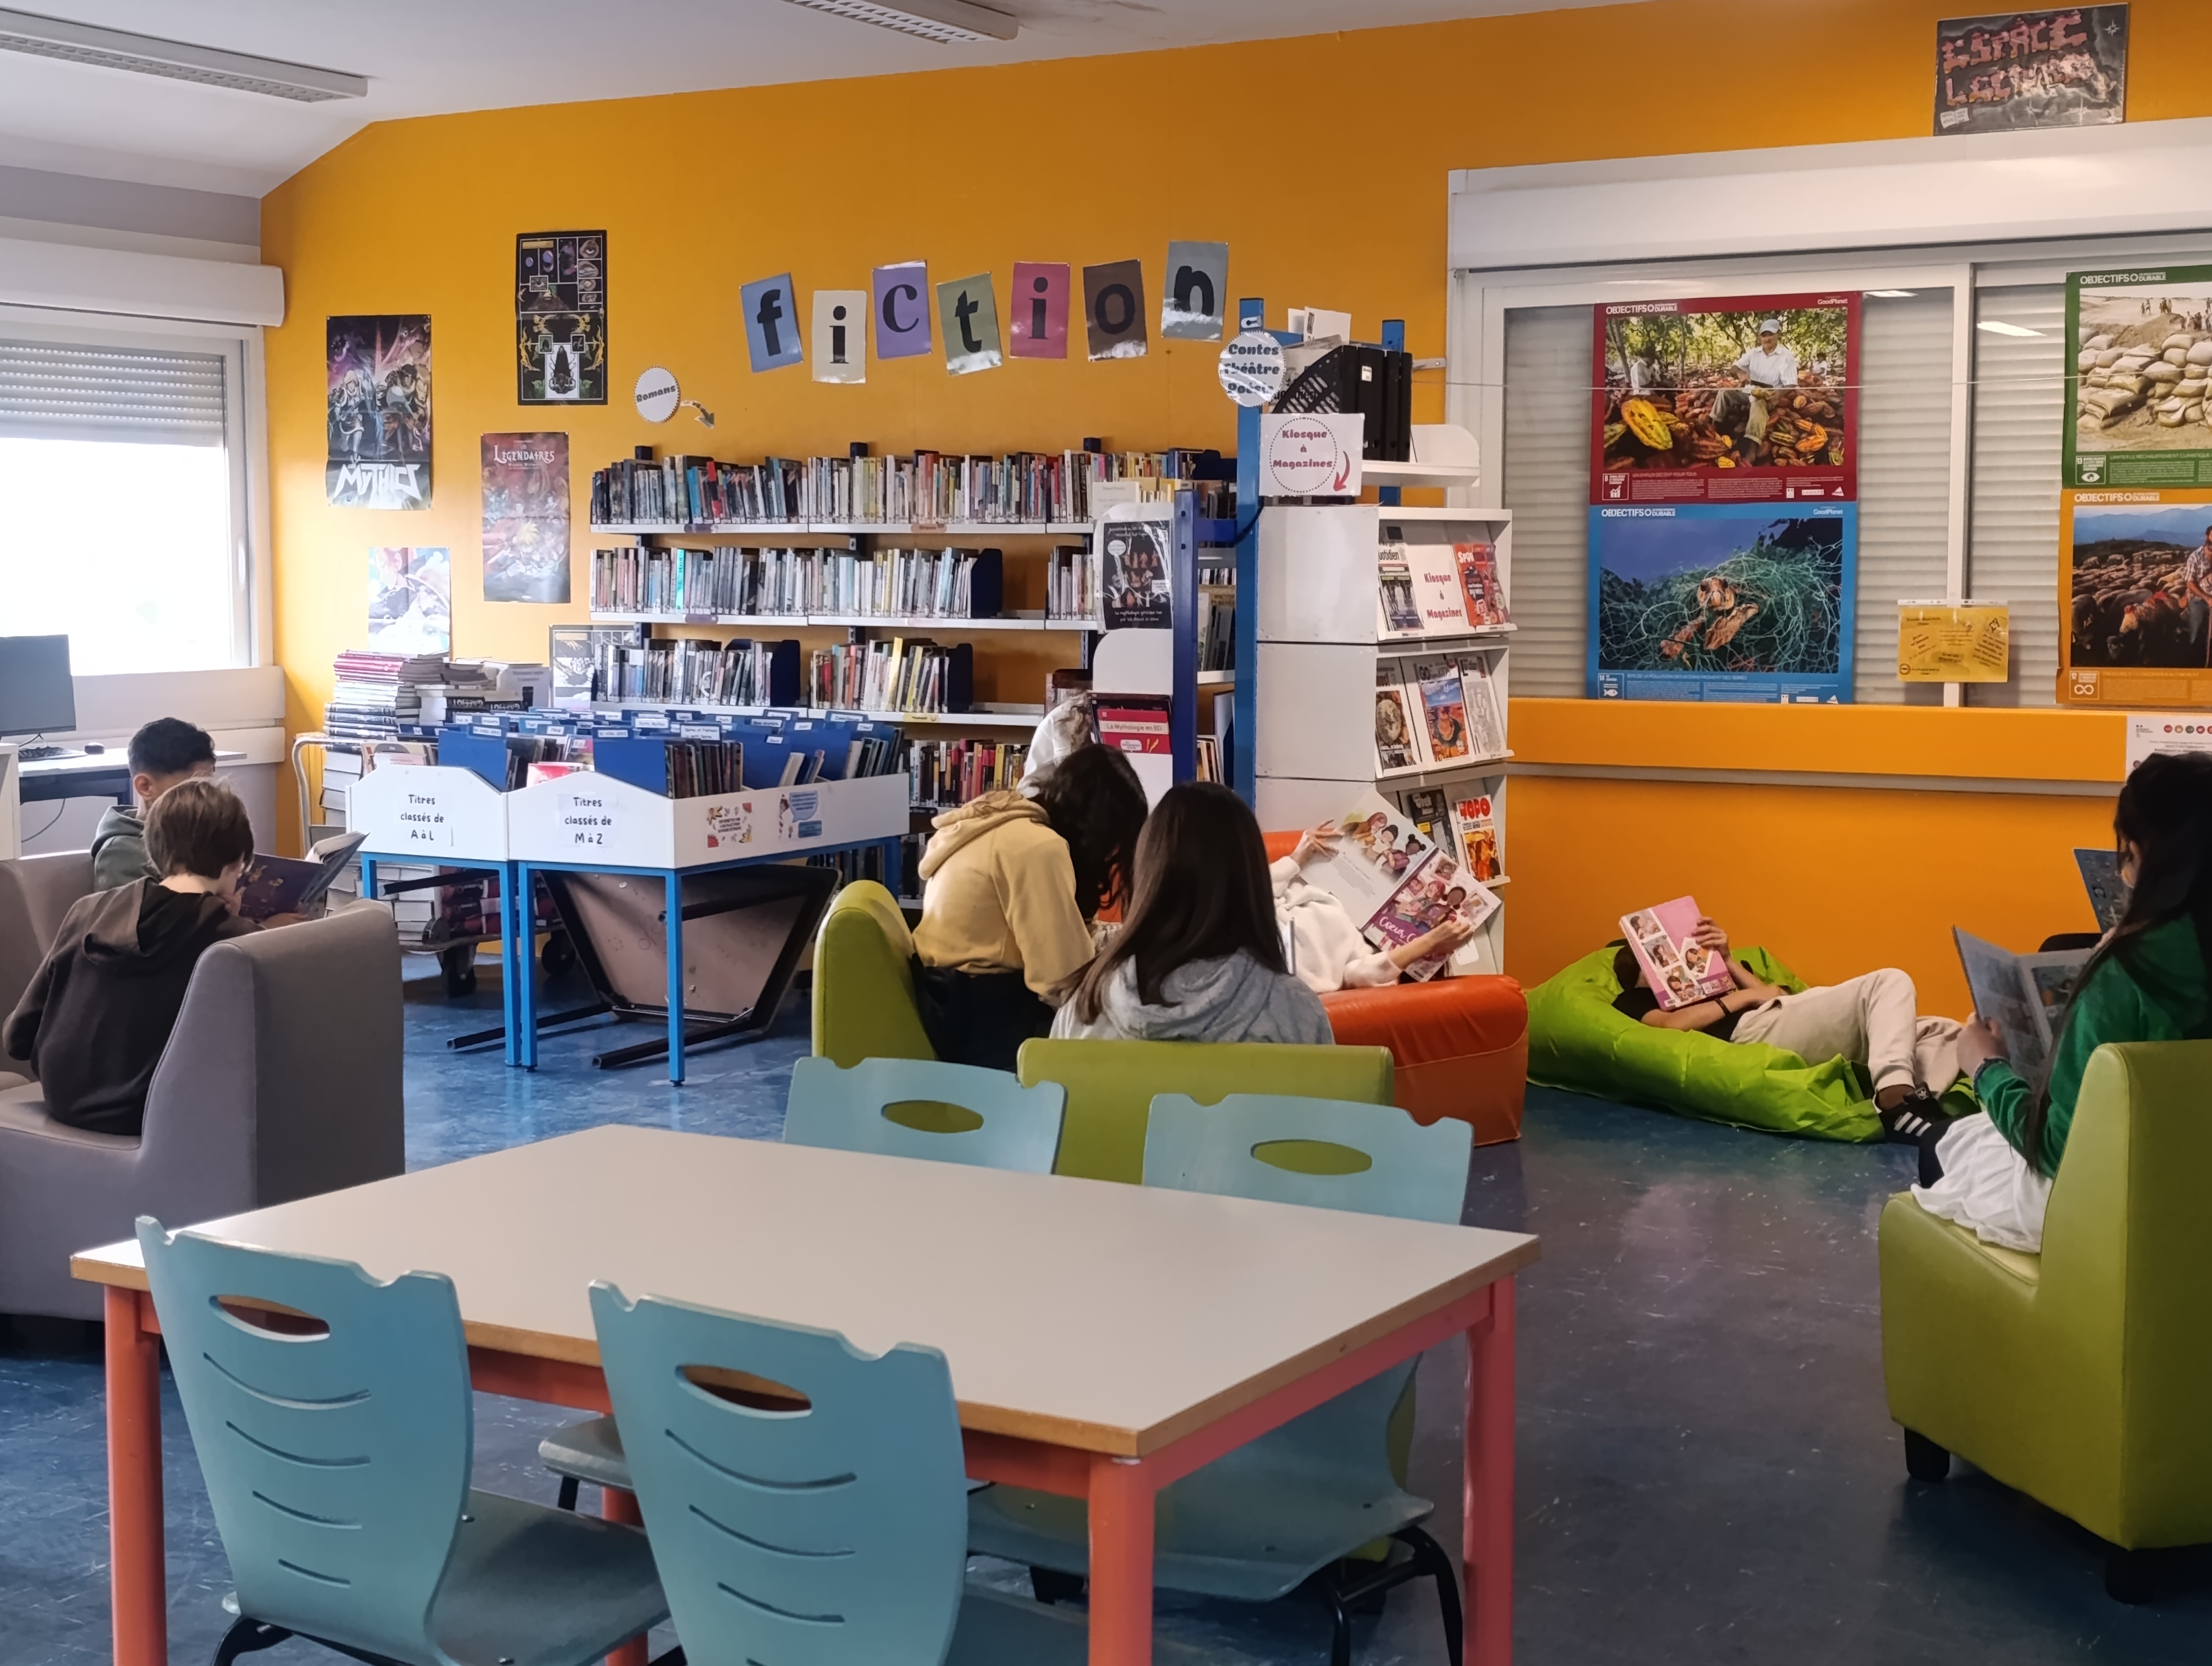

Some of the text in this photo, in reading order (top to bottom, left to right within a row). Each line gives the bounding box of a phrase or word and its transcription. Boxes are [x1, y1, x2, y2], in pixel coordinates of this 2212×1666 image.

[1941, 9, 2088, 74] ESPACE
[2080, 274, 2130, 285] OBJECTIFS
[757, 265, 1214, 364] fiction
[1606, 304, 1647, 315] OBJECTIFS
[1228, 344, 1279, 355] Contes
[636, 385, 676, 402] Romans
[1282, 429, 1327, 440] Kiosque
[1300, 445, 1307, 453] à
[1273, 459, 1333, 470] Magazines
[2074, 493, 2124, 502] OBJECTIFS
[1602, 508, 1644, 517] OBJECTIFS
[1424, 573, 1451, 585] Kiosque
[1439, 590, 1444, 600] à
[1426, 607, 1462, 620] Magazines
[408, 794, 436, 805] Titres
[573, 797, 602, 808] Titres
[400, 811, 445, 824] classés de
[564, 815, 612, 826] classés de
[410, 830, 434, 841] A à L
[575, 834, 603, 845] M à Z
[1379, 916, 1406, 939] Coeur
